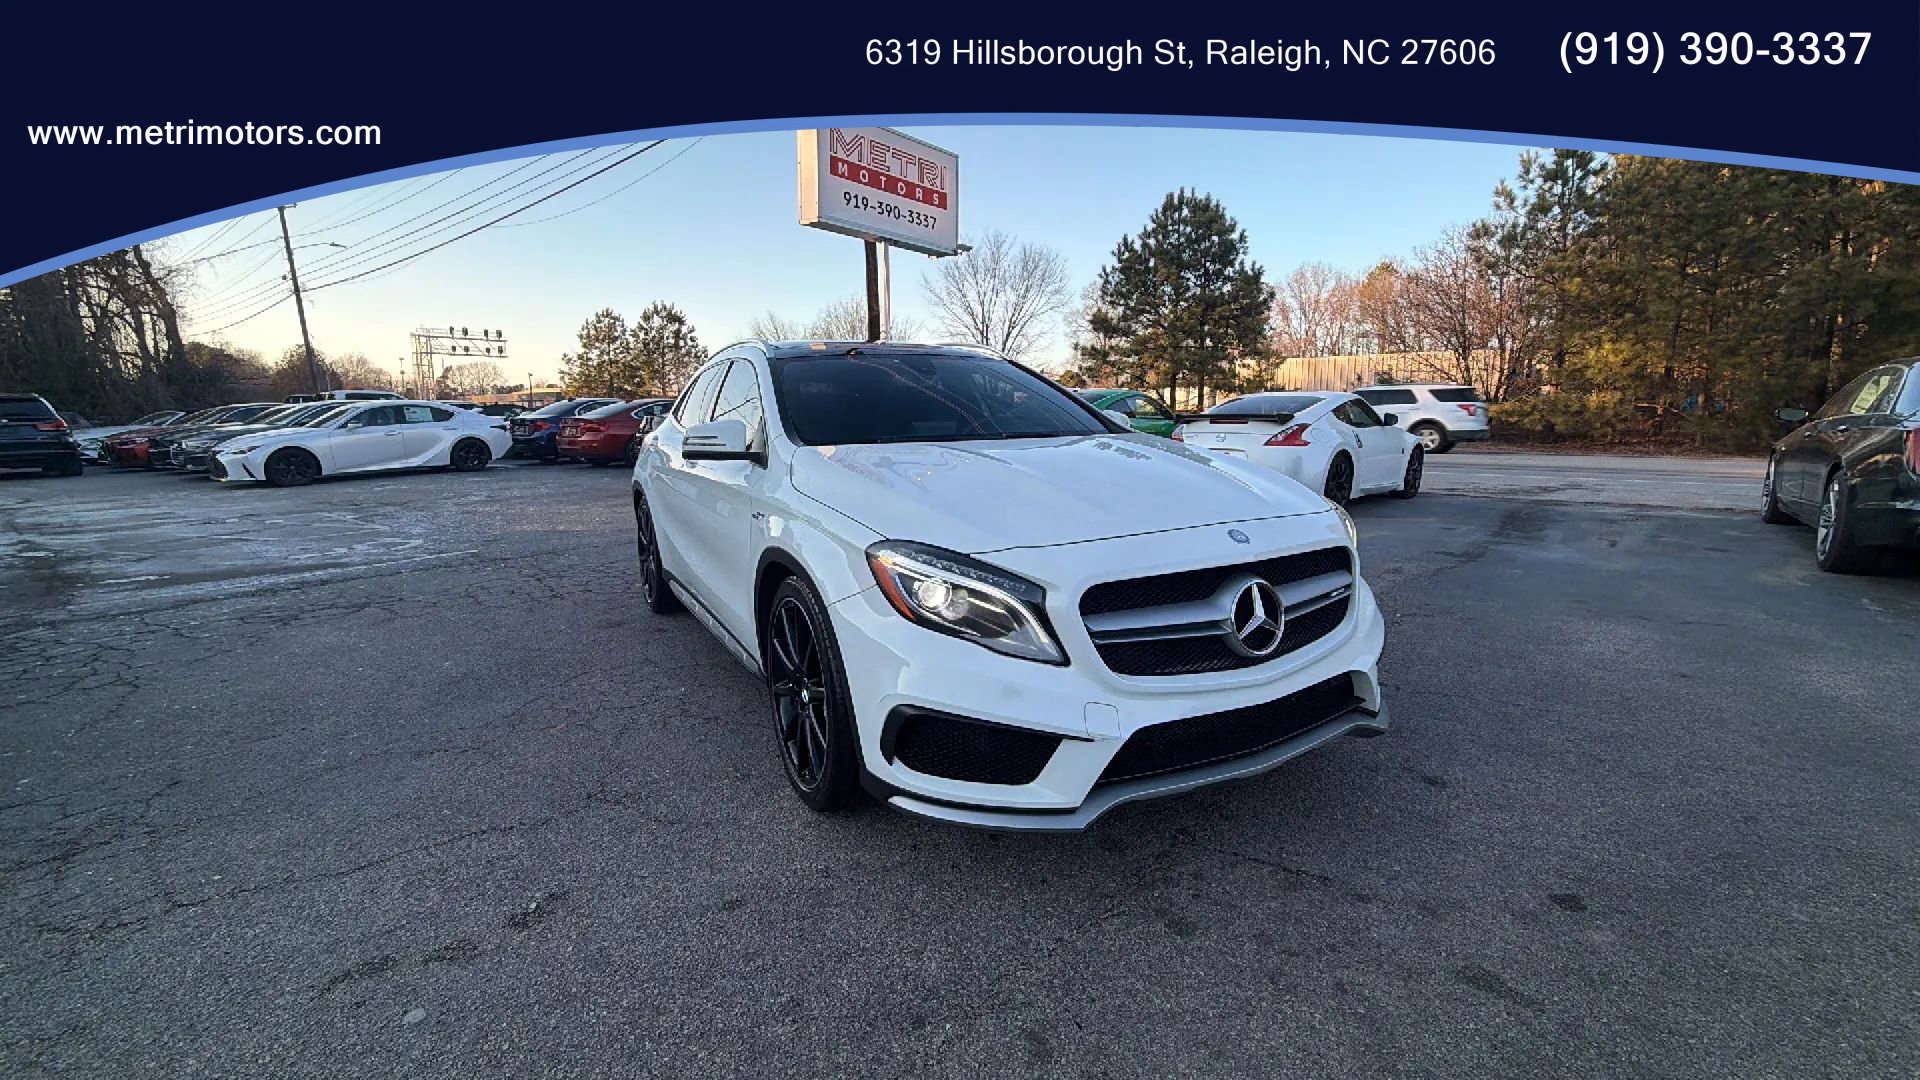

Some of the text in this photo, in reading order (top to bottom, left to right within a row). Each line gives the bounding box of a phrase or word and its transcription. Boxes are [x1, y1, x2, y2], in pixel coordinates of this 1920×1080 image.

[829, 128, 947, 190] METRI
[837, 161, 939, 205] MOTORS
[843, 191, 937, 230] 919-390-3337
